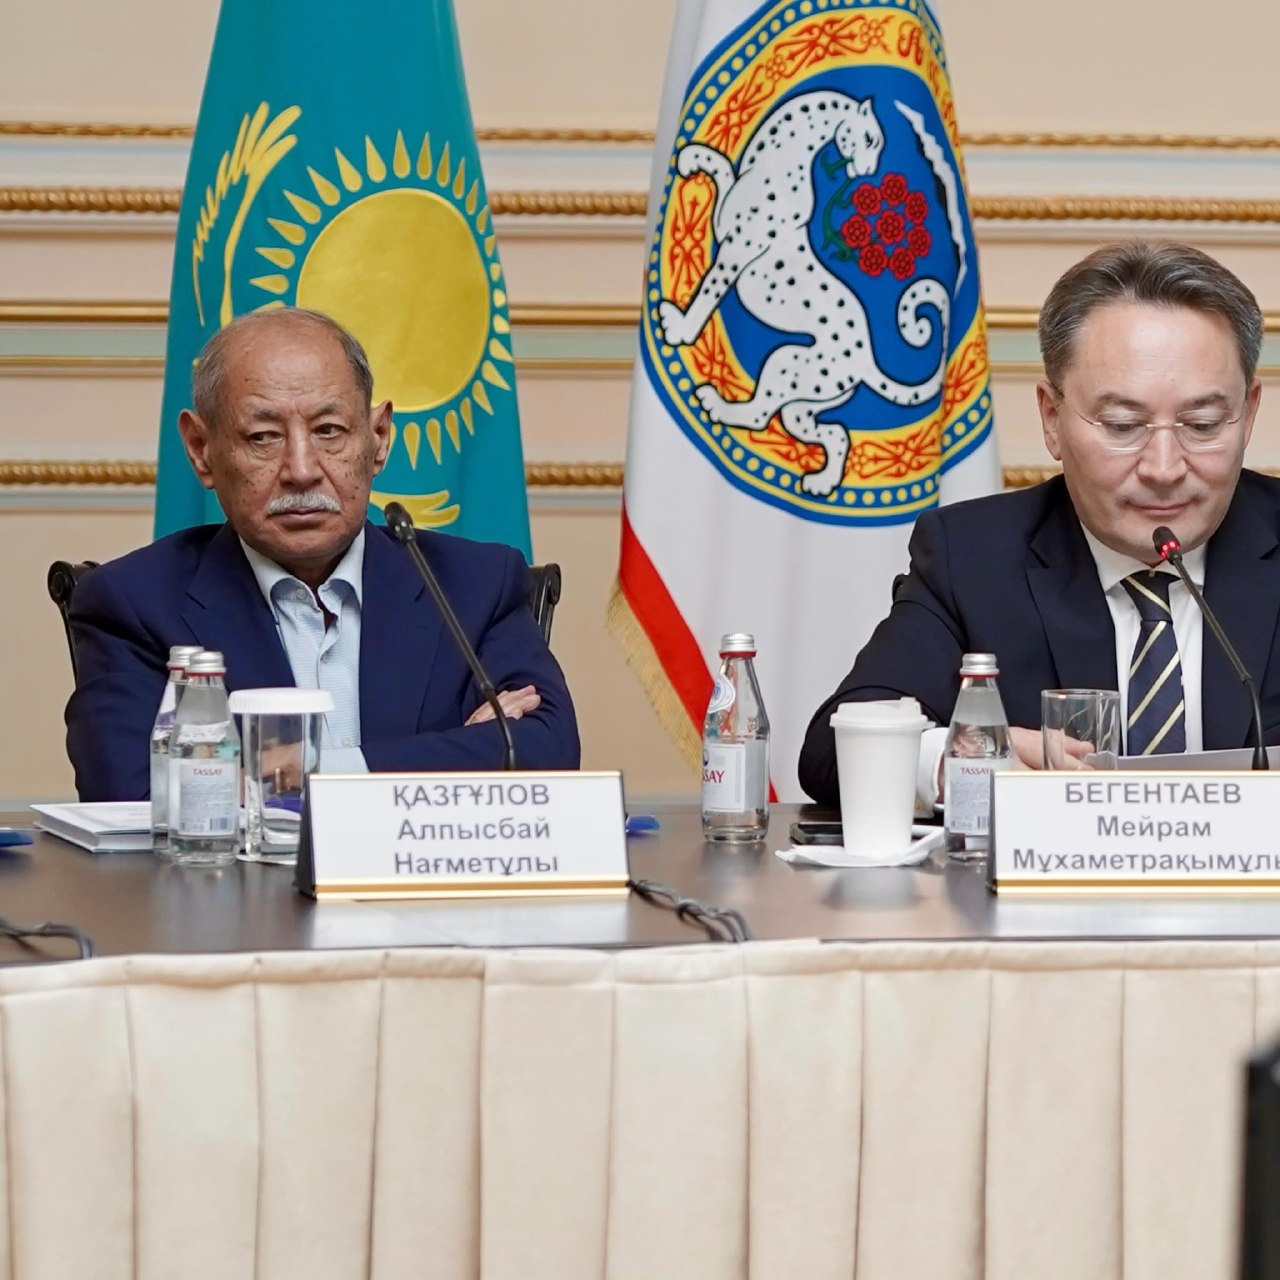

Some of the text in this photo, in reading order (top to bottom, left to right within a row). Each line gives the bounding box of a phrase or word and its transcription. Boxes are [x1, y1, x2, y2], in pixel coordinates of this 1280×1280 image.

[960, 766, 990, 775] TASSAY
[393, 784, 550, 810] ҚАЗҒҰЛОВ
[1065, 783, 1242, 804] БЕГЕНТАЕВ
[397, 817, 550, 840] Алпысбай
[1097, 815, 1211, 841] Мейрам
[394, 853, 559, 876] Нағметұлы
